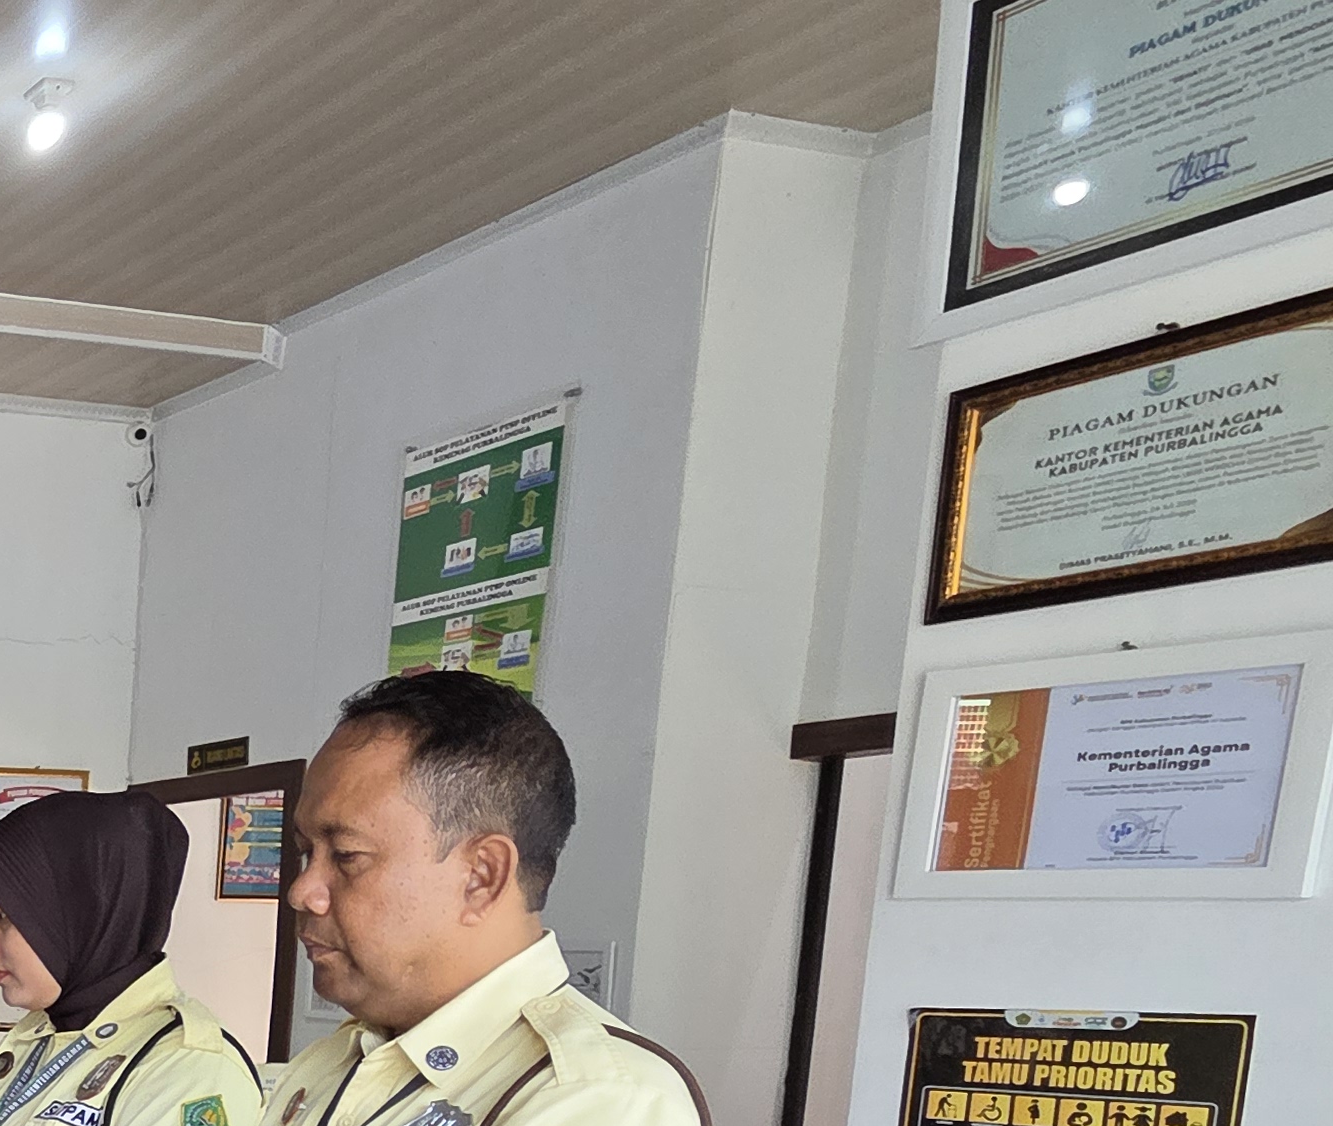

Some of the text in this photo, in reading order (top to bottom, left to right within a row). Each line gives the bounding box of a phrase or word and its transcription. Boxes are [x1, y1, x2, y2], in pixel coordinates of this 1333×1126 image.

[1129, 21, 1197, 58] PIAGAM
[1048, 409, 1137, 441] PIAGAM
[1142, 373, 1280, 419] DUKUNGAN
[1034, 446, 1100, 471] KANTOR
[1103, 418, 1215, 455] KEMENTERIAN
[1219, 404, 1284, 427] AGAMA
[1048, 451, 1139, 478] KABUPATEN
[1143, 422, 1264, 457] PURBALINGGA
[1077, 740, 1251, 763] Kementerian Agama
[1108, 756, 1211, 774] Purbalingga
[964, 780, 992, 868] Sertifikat
[975, 1036, 1170, 1067] TEMPAT DUDUK
[962, 1061, 1176, 1095] TAMU PRIORITAS
